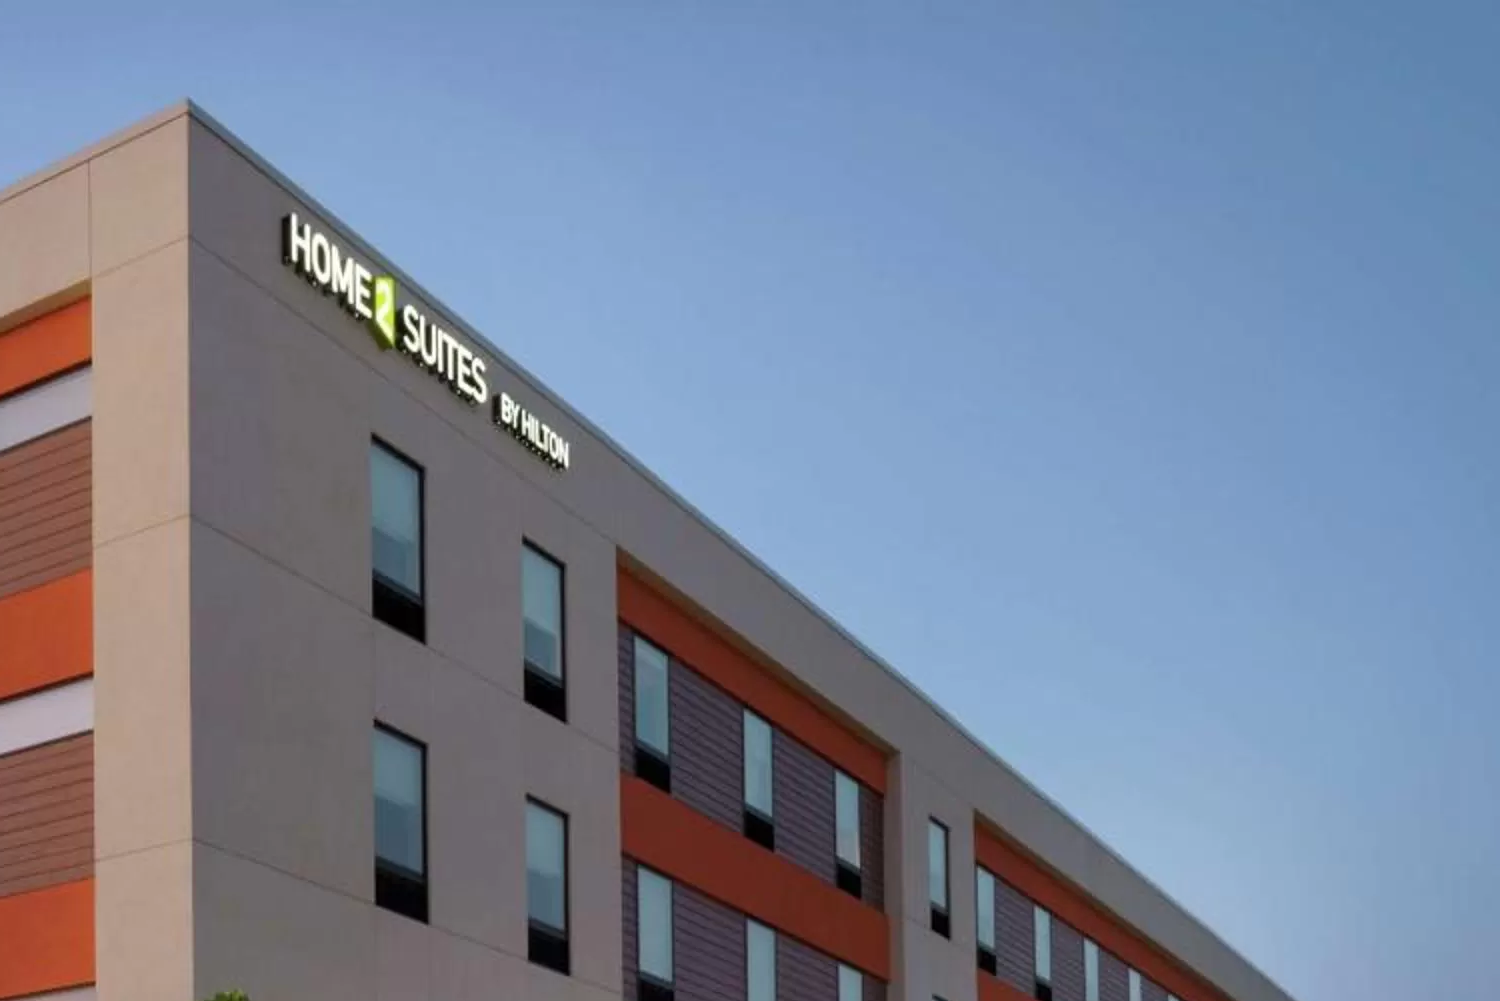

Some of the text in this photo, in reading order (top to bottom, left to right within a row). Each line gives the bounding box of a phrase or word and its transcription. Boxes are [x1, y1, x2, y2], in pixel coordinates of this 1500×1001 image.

[403, 304, 488, 404] SUITES
[501, 392, 520, 429] BY
[521, 408, 569, 470] HILTON
